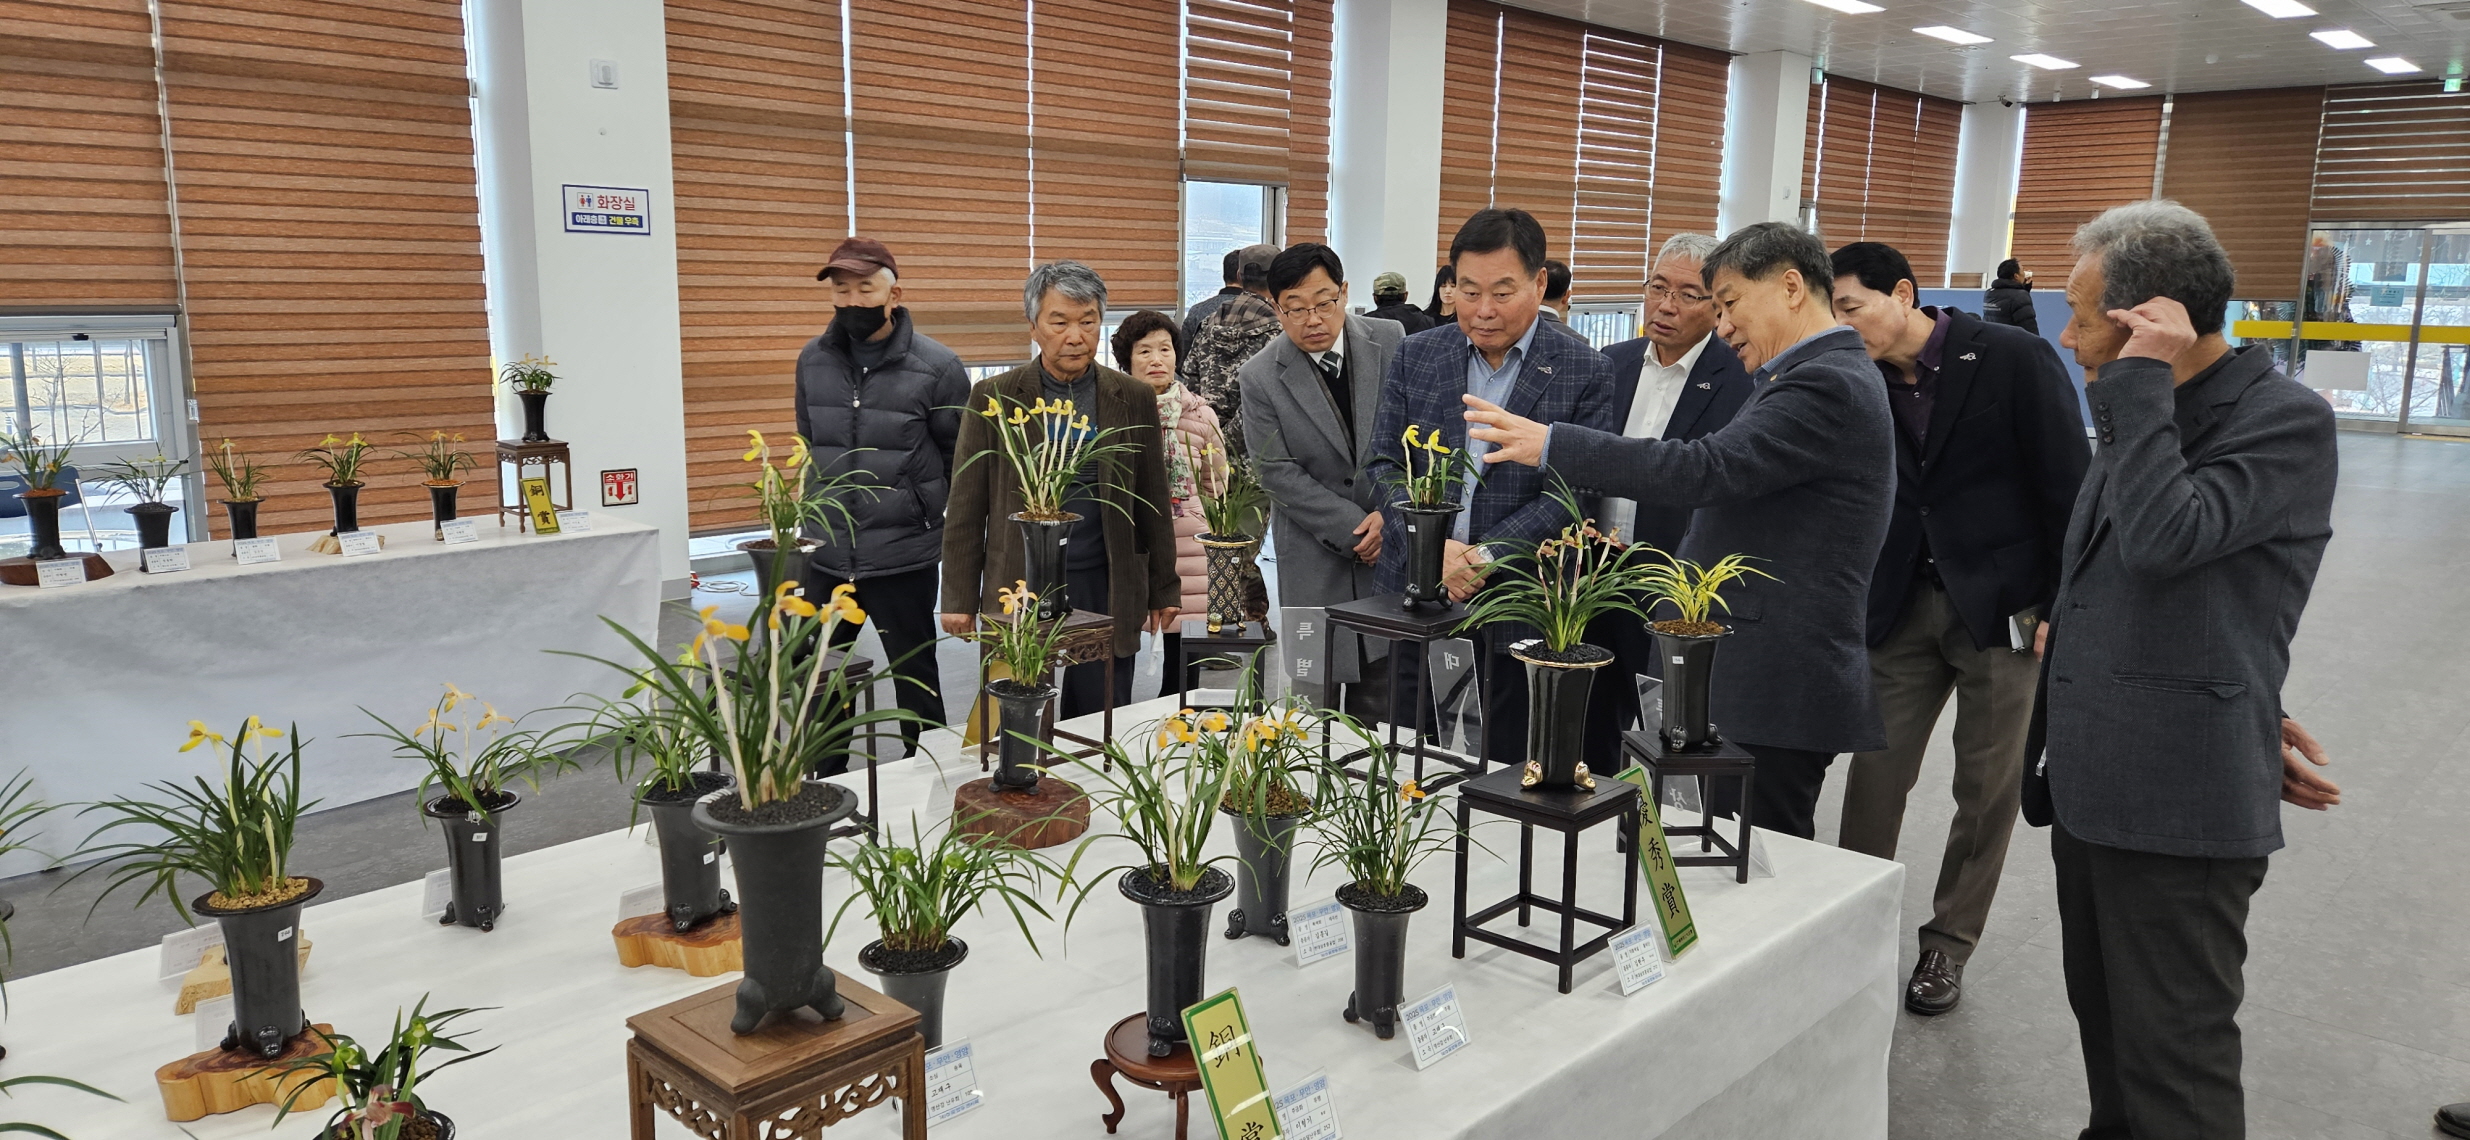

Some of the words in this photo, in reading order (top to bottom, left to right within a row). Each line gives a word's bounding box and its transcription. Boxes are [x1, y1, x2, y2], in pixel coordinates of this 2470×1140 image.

[597, 194, 635, 211] 화장실
[605, 473, 634, 482] 소화기
[1293, 915, 1306, 923] 2025
[1406, 1009, 1419, 1021] 2025
[926, 1048, 969, 1069] 포·무안·영암
